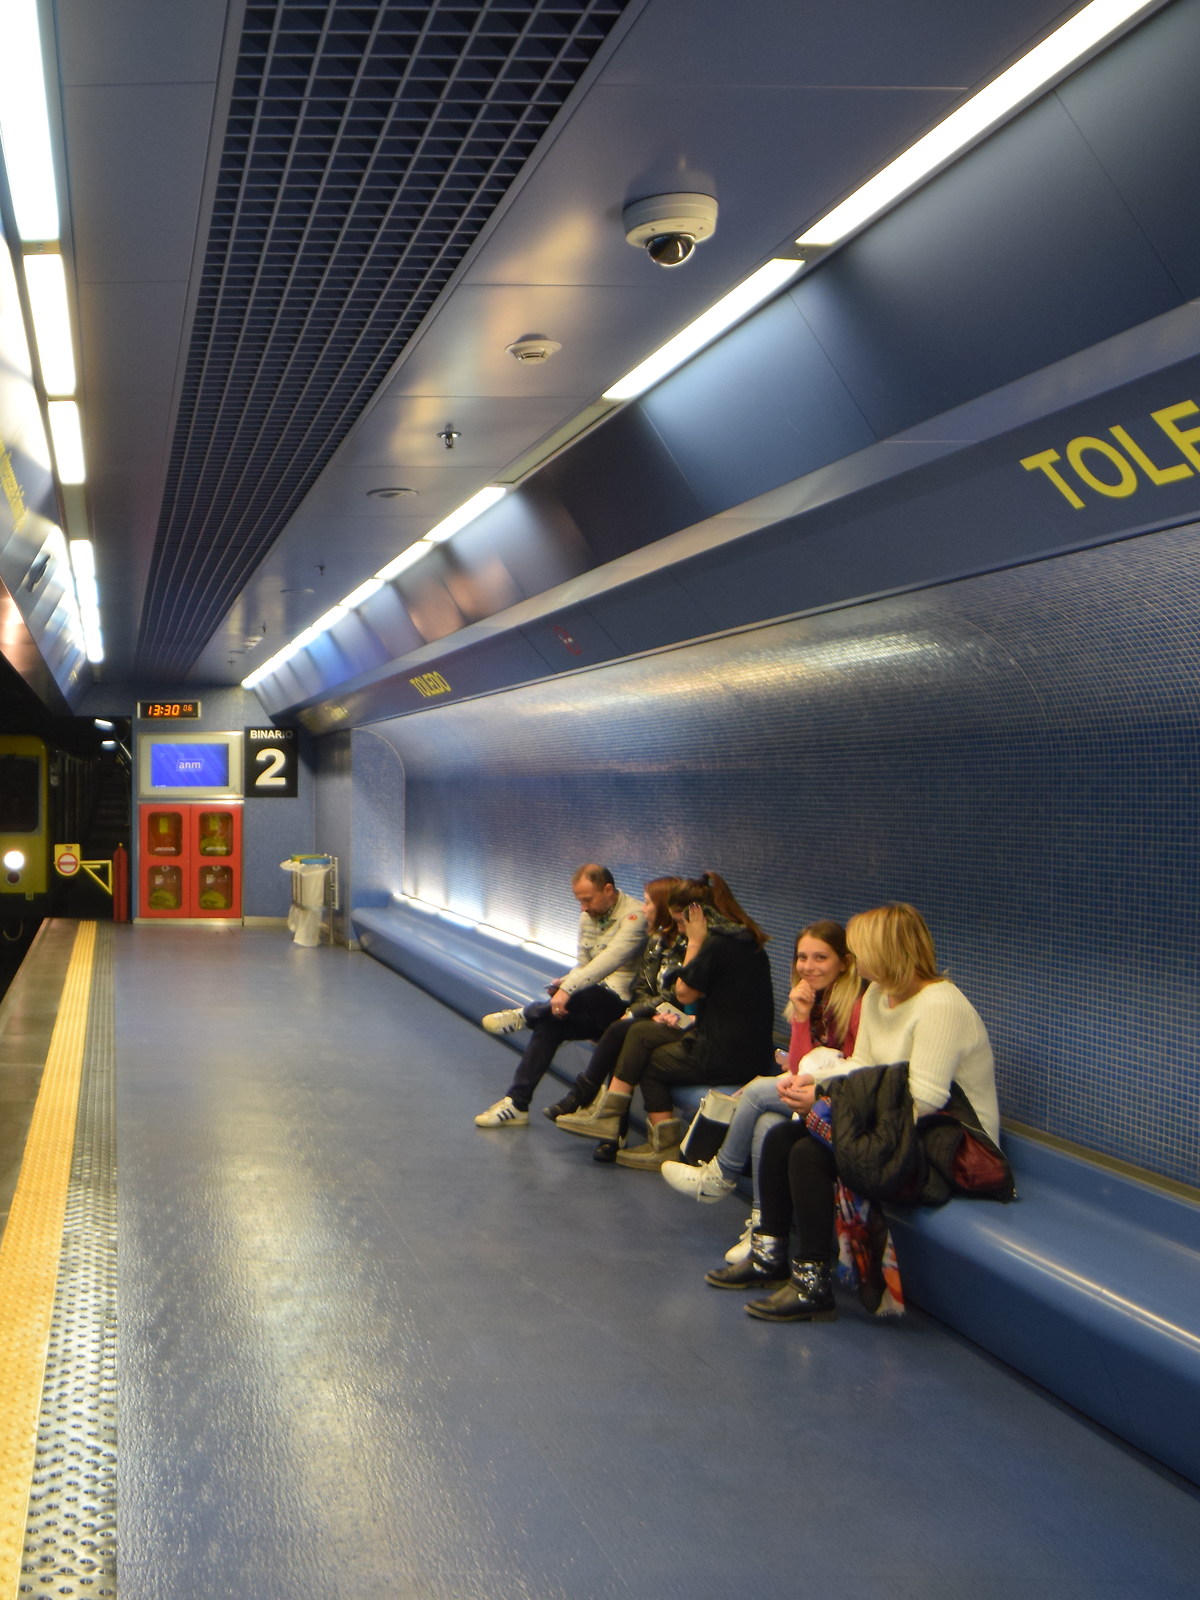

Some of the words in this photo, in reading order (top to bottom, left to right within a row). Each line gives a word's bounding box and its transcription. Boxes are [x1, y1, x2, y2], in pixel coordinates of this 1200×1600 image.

[409, 670, 452, 698] TOLEDO
[148, 704, 180, 716] 13:30
[178, 761, 201, 769] anm
[255, 747, 286, 786] 2
